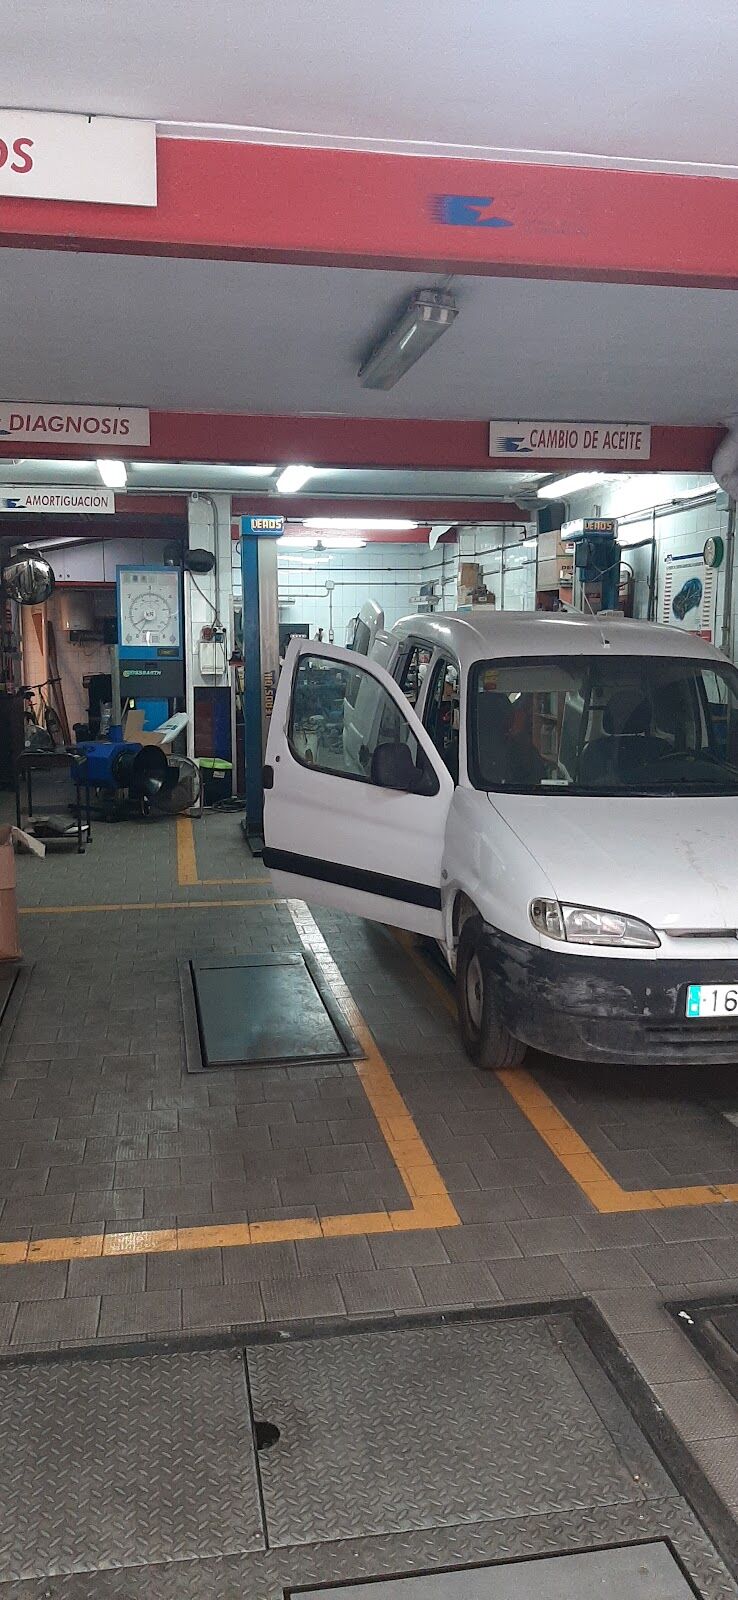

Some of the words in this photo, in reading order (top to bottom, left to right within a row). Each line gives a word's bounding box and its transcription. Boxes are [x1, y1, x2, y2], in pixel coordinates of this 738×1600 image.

[9, 414, 130, 435] DIAGNOSIS
[529, 429, 579, 449] CAMBIO
[583, 431, 599, 449] DE
[602, 431, 643, 450] ACEITE
[25, 495, 109, 507] AMORTIGUACION
[712, 989, 738, 1012] 16
